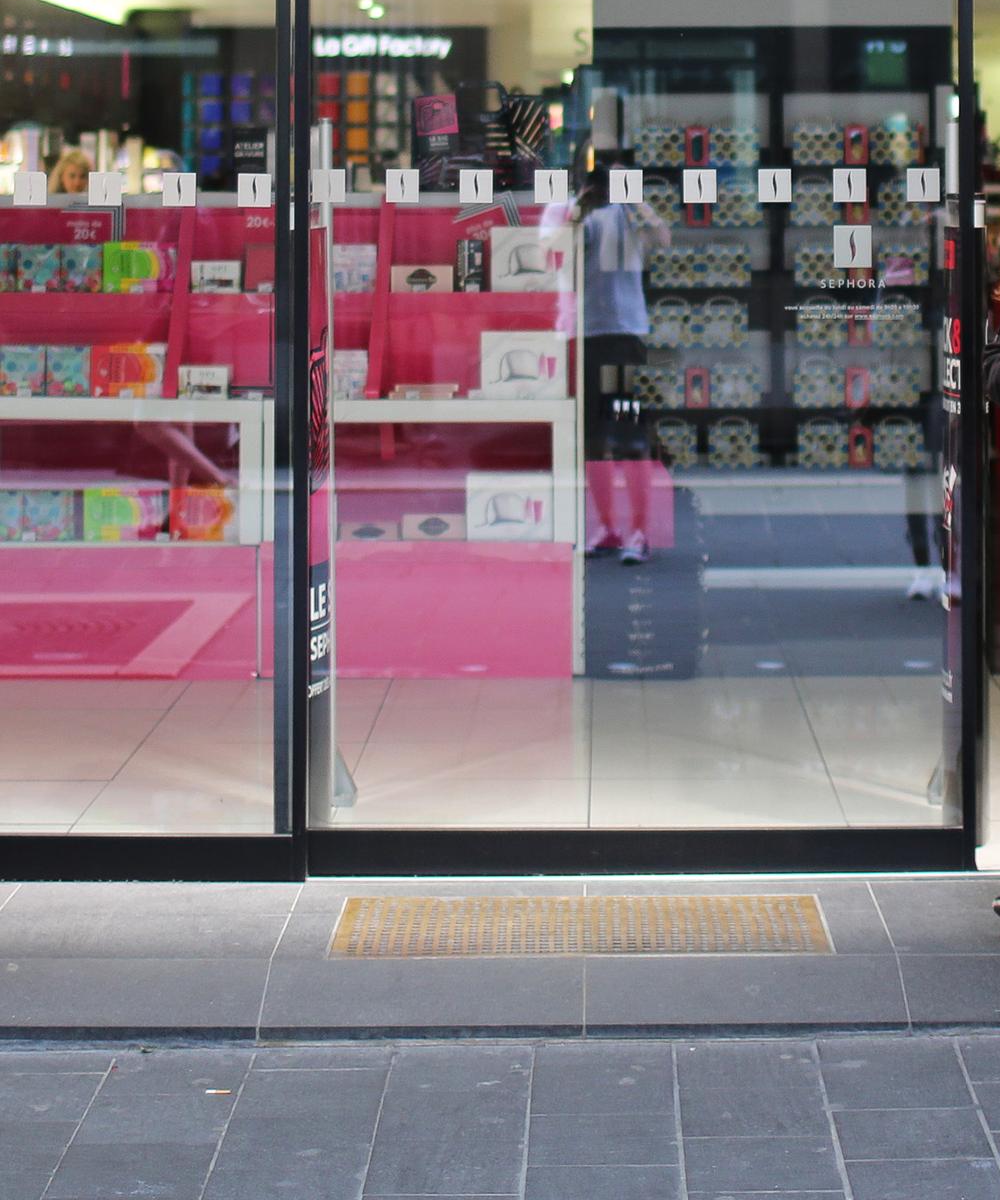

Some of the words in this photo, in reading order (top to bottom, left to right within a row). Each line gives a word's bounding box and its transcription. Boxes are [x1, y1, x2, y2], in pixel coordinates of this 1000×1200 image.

[378, 33, 452, 60] Factory
[820, 278, 887, 289] SEPHORA
[310, 583, 327, 621] LE
